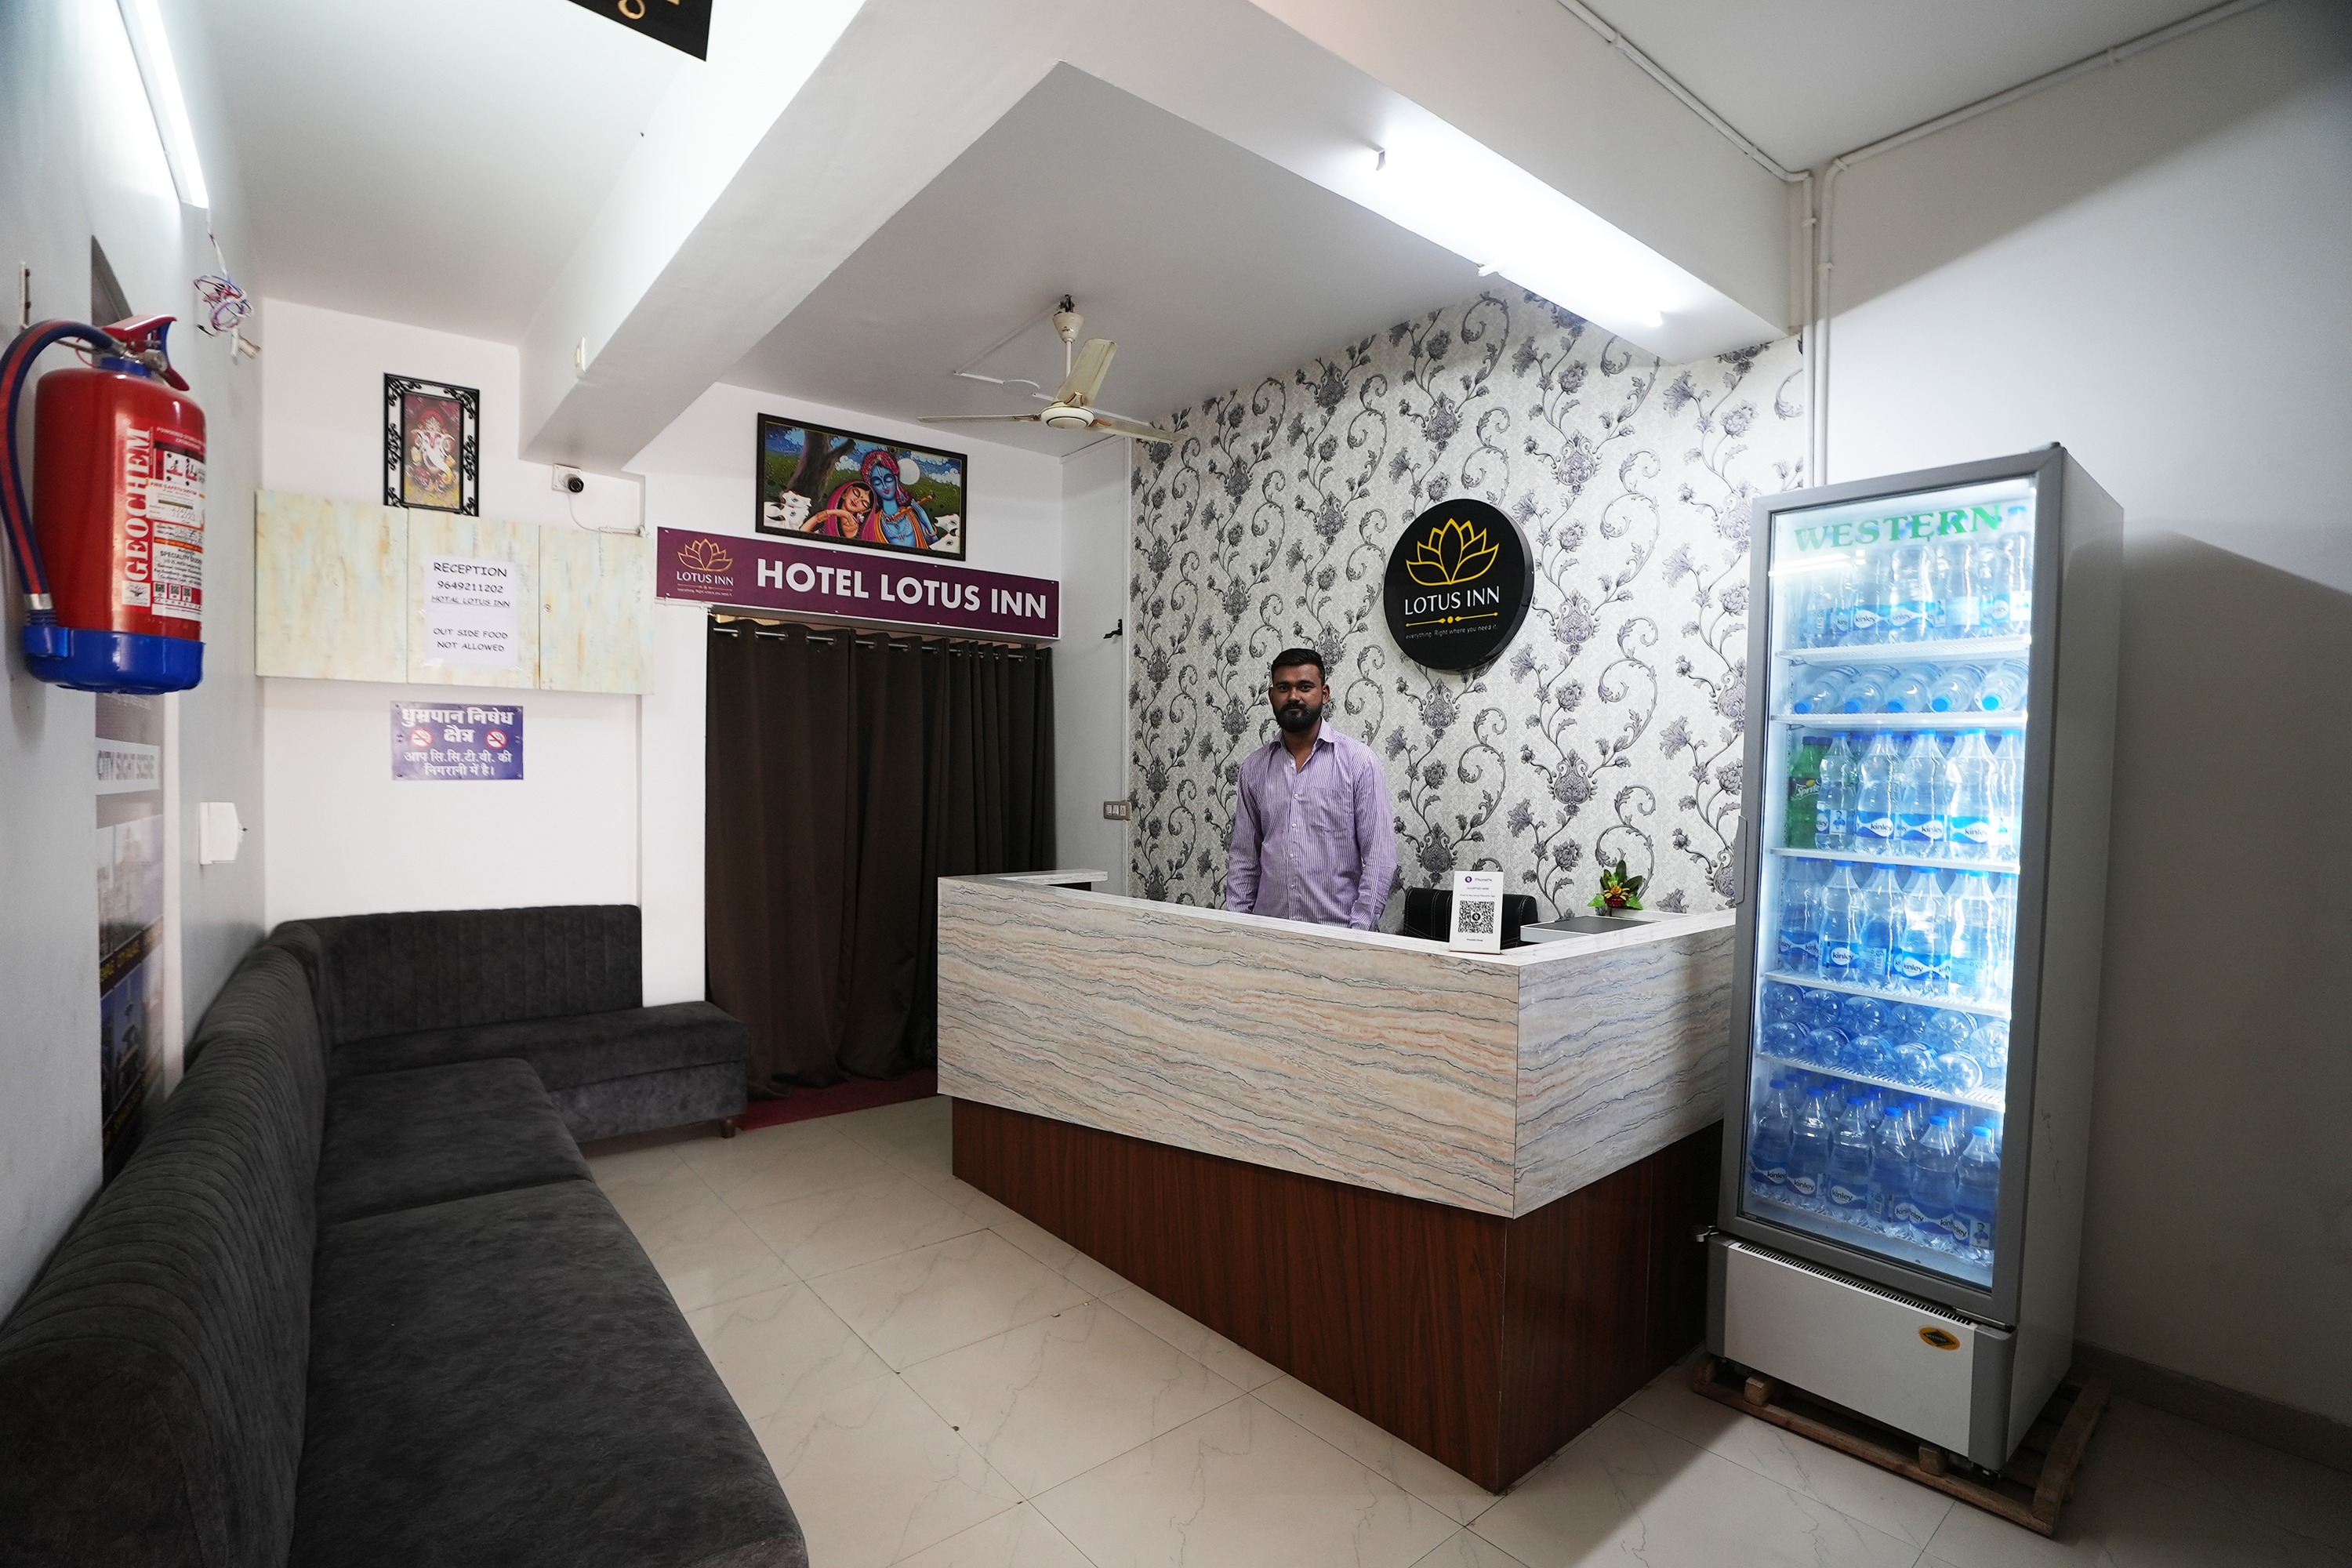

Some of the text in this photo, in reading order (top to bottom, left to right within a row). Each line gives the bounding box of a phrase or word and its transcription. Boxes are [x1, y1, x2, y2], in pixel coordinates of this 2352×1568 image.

[125, 427, 151, 582] GEOCHEM
[1795, 504, 2000, 552] WESTERN
[434, 562, 507, 577] RECEPTION
[677, 571, 734, 586] LOTUS INN
[437, 580, 503, 593] 9649211202
[757, 557, 1047, 619] HOTEL LOTUS INN
[463, 597, 491, 606] LOTUS
[1405, 586, 1500, 615] LOTUS INN
[456, 629, 480, 637] SIDE
[483, 630, 508, 639] FOOD
[437, 641, 505, 652] NOT ALLOWED
[467, 707, 514, 725] निषेध
[404, 752, 428, 763] आप
[497, 750, 513, 764] की
[423, 763, 467, 777] निगरानी
[469, 763, 479, 776] में
[1832, 952, 1854, 960] kinley
[1767, 1171, 1786, 1180] kinley
[1794, 1179, 1814, 1190] kinley
[1831, 1189, 1853, 1202] kinley
